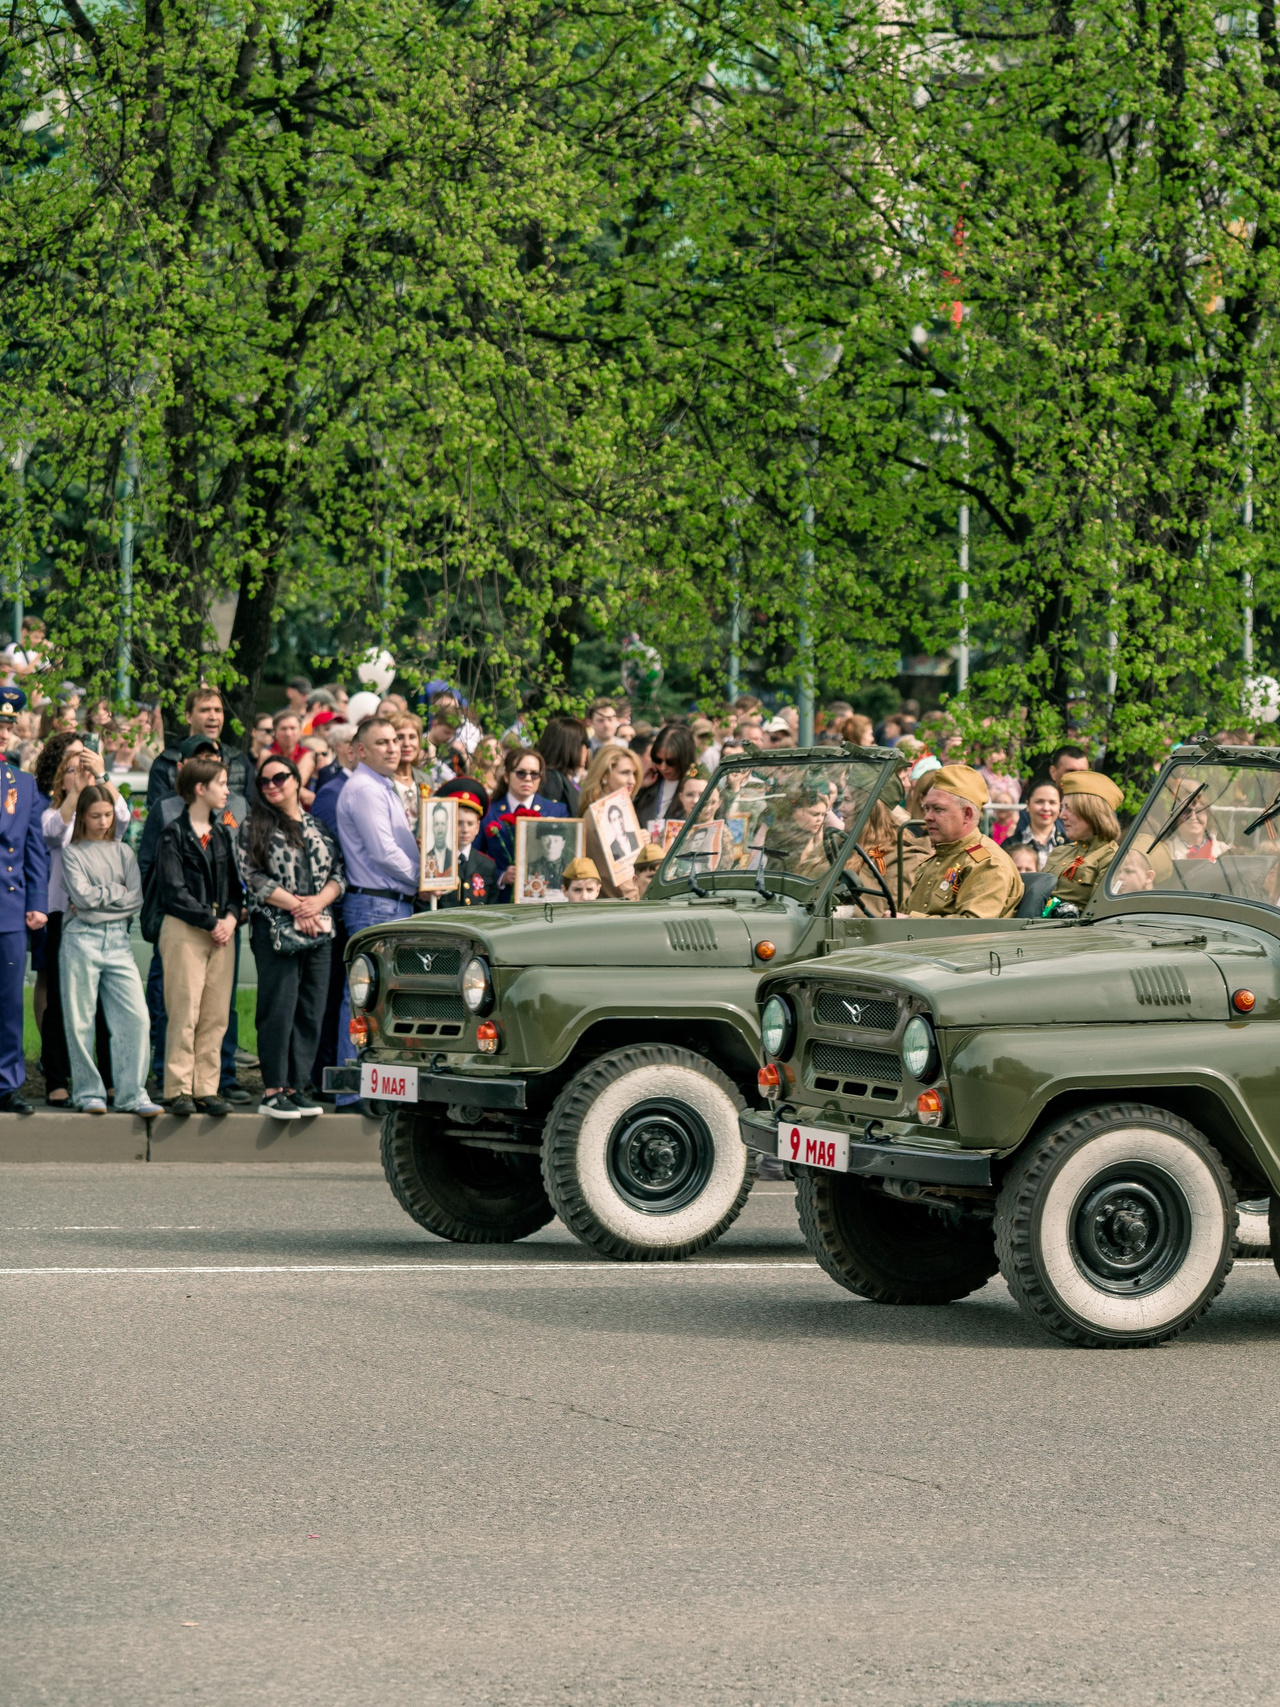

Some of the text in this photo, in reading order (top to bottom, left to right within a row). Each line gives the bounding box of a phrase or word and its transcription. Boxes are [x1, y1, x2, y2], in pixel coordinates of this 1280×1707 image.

[371, 1068, 406, 1096] 9 МАЯ
[790, 1128, 835, 1167] 9 МАЯ
